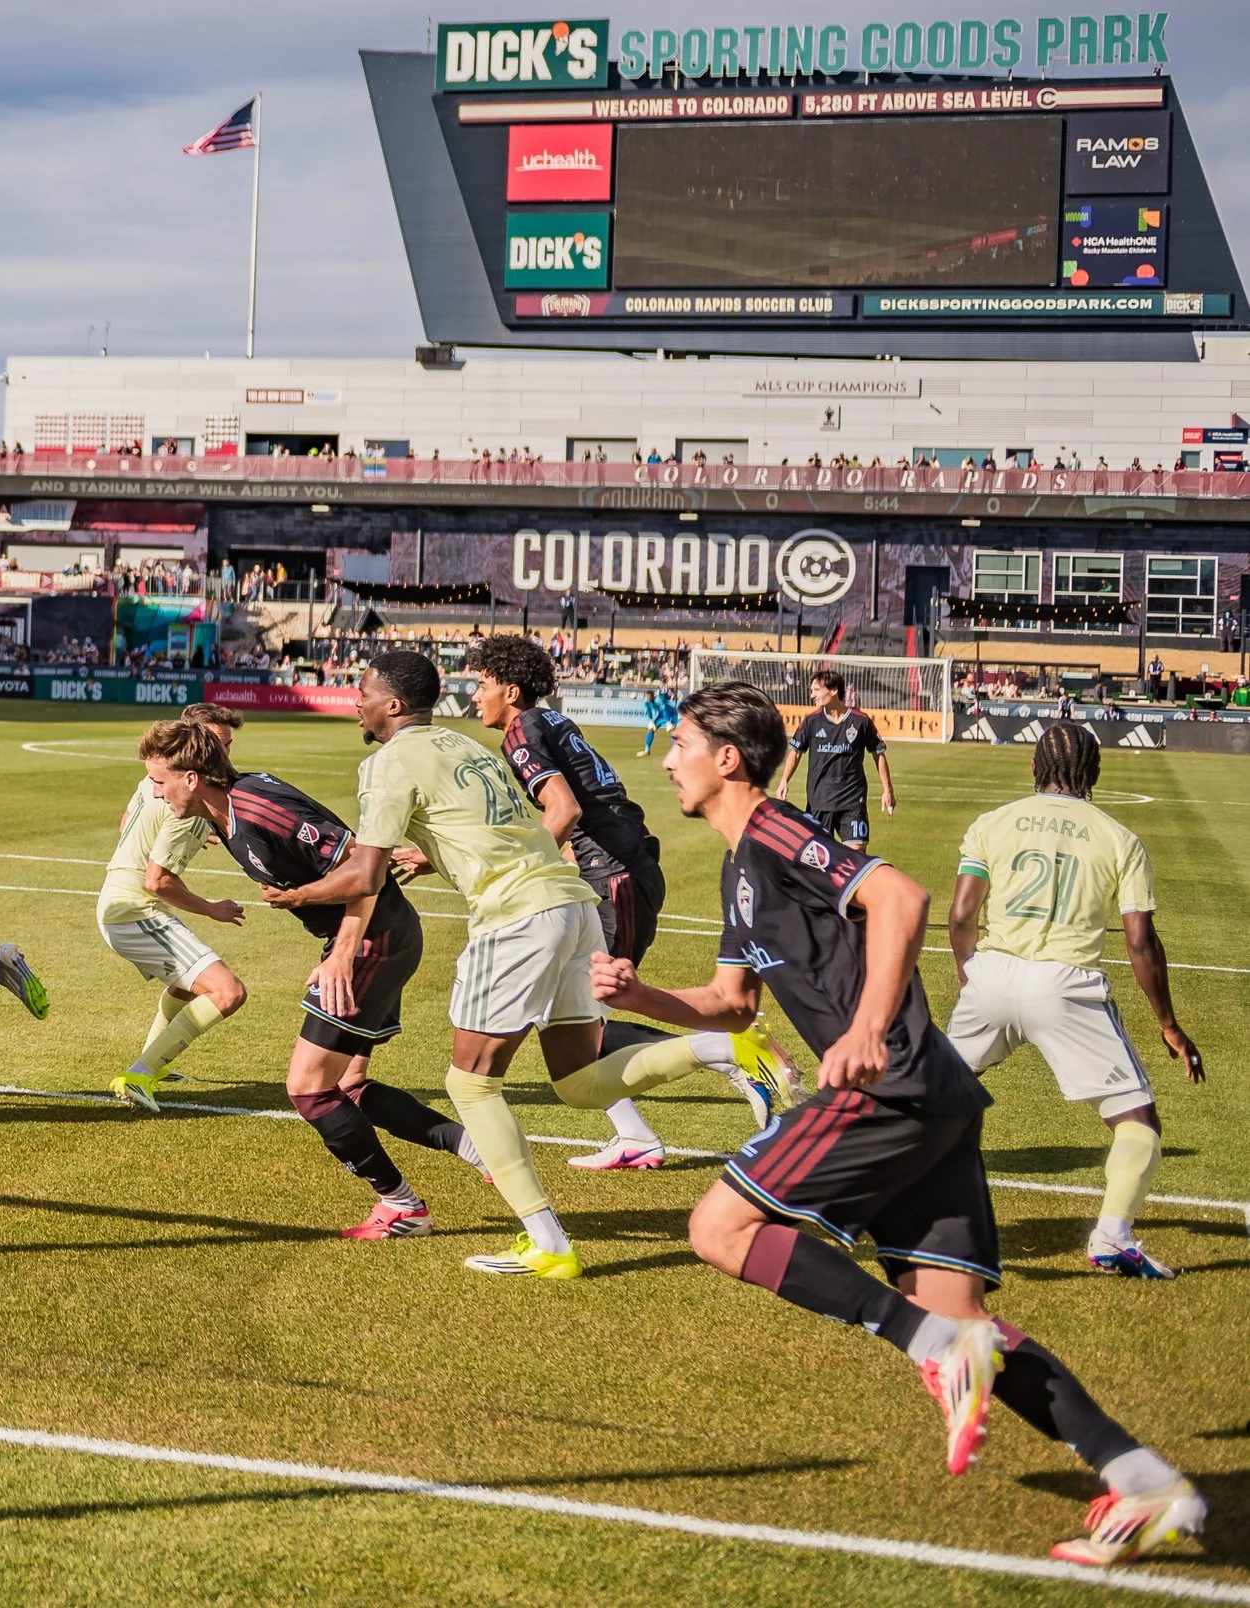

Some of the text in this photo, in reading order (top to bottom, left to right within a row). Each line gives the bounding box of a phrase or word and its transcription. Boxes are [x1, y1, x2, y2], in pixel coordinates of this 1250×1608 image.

[445, 12, 1170, 83] DICK'S SPORTING GOODS PARK
[595, 96, 788, 118] WELCOME TO COLORADO
[805, 94, 852, 115] 5,280
[858, 93, 876, 112] FT
[881, 92, 937, 111] ABOVE
[943, 91, 976, 109] SEA
[981, 89, 1032, 108] LEVEL
[522, 148, 597, 169] uchealth
[1091, 154, 1142, 169] LAW
[509, 233, 602, 271] DICK'S
[1083, 236, 1157, 247] HCA HealthONE
[625, 297, 833, 313] COLORADO RAPIDS SOCCER CLUB
[880, 298, 1153, 311] DICKSSPORTINGGOODSPARK.COM
[1166, 299, 1201, 311] DICK'S
[754, 381, 907, 393] MLS CUP CHAMPIONS
[634, 466, 1067, 490] COLORADO RAPIDS
[31, 480, 343, 499] AND STADIUM STAFF WILL ASSIST YOU.
[513, 528, 770, 596] COLORADO
[52, 680, 102, 701] DICK'S
[136, 682, 187, 703] DICK'S
[215, 690, 257, 703] uchealth
[269, 694, 289, 703] LIVE
[570, 732, 621, 787] 2
[851, 820, 868, 838] 10
[1015, 816, 1090, 842] CHARA
[1005, 848, 1080, 924] 21
